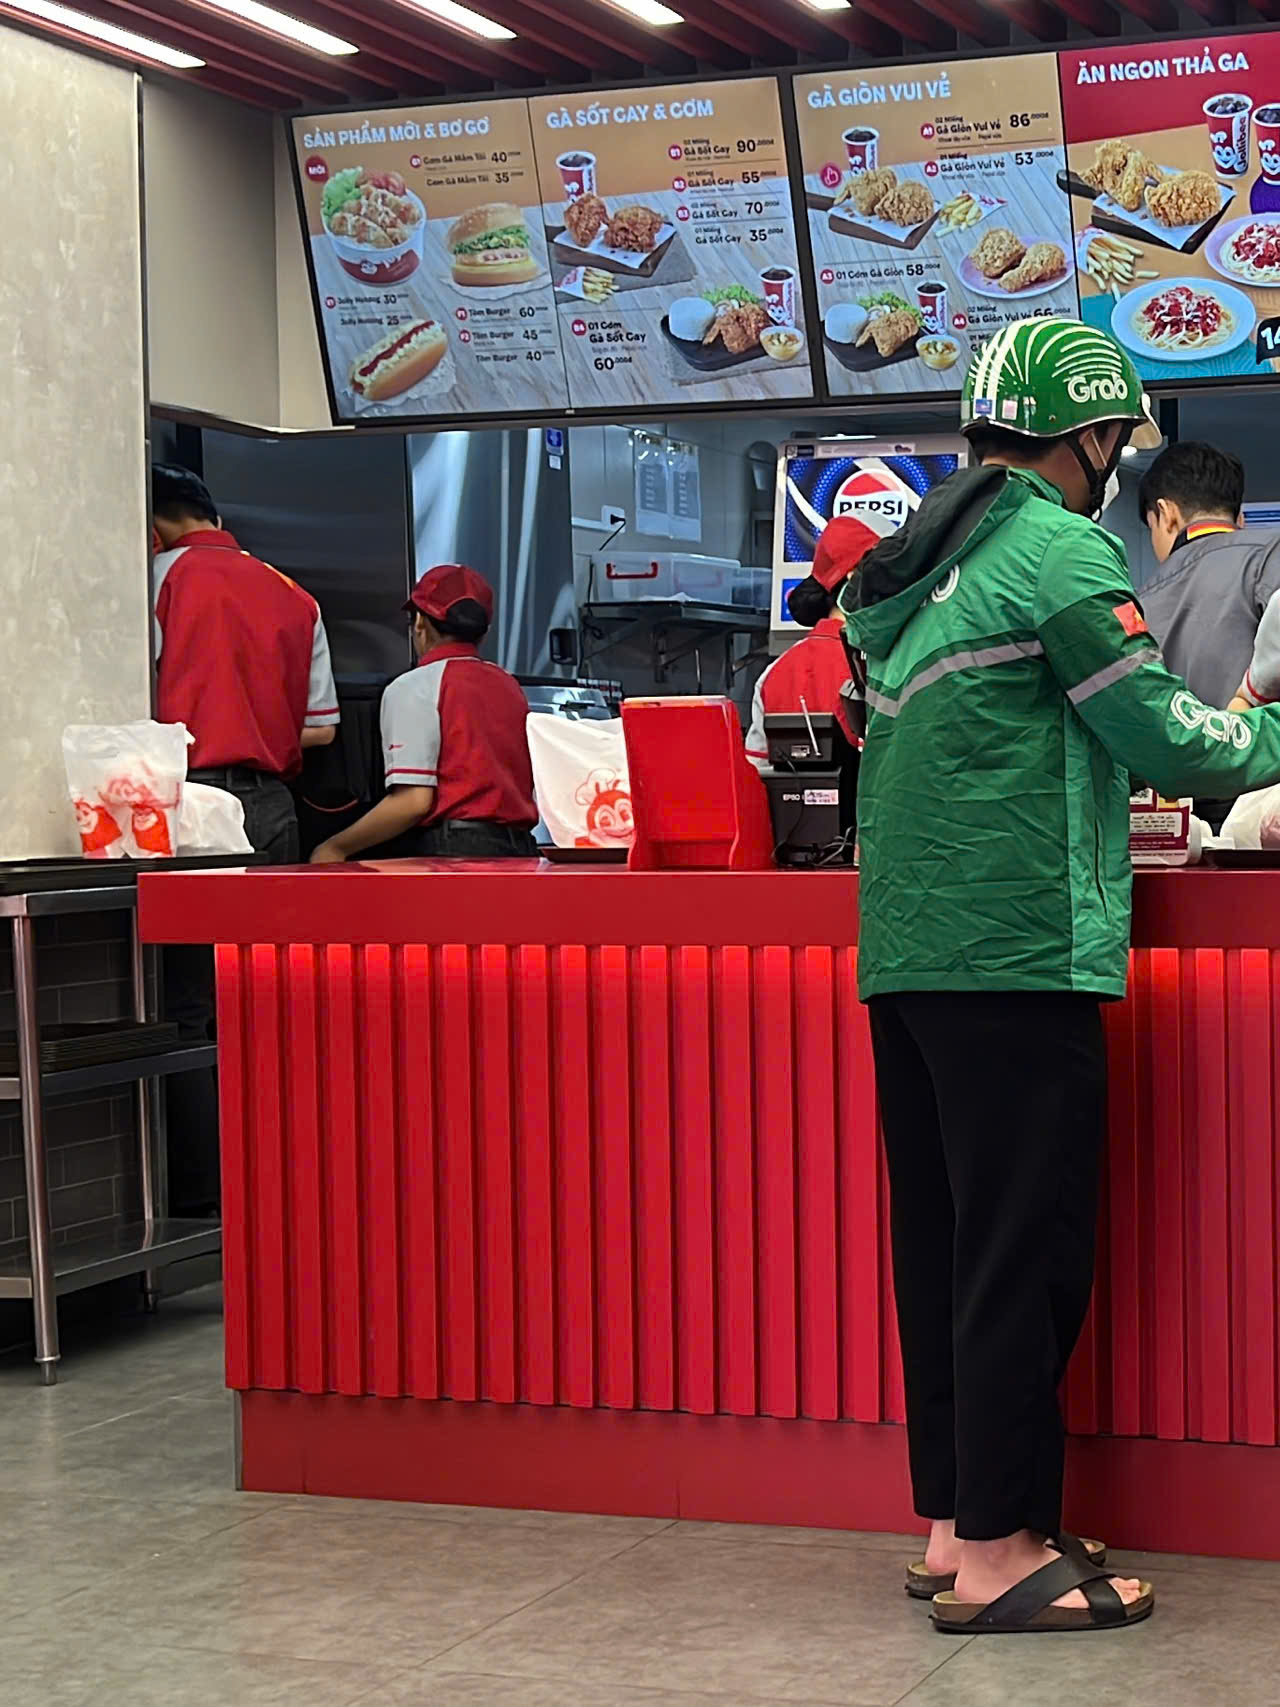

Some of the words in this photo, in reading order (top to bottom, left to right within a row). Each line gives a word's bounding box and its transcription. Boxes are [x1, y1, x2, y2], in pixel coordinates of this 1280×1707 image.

[1076, 61, 1106, 85] ĂN
[1109, 57, 1170, 82] NGON
[1172, 47, 1216, 77] THẢ
[1218, 52, 1249, 72] GA
[808, 83, 837, 109] GÀ
[838, 81, 887, 107] GIÒN
[889, 83, 922, 101] VUI
[926, 71, 952, 99] VẺ
[546, 107, 574, 129] GÀ
[576, 102, 611, 127] SỐT
[612, 104, 650, 123] CAY
[653, 104, 668, 121] &
[669, 99, 714, 119] CƠM
[303, 127, 337, 149] SẢN
[338, 119, 387, 146] PHẨM
[424, 122, 438, 139] &
[625, 332, 646, 343] Cay
[1067, 372, 1129, 404] Grab
[839, 500, 904, 516] PEPSI
[782, 793, 801, 801] EPSO
